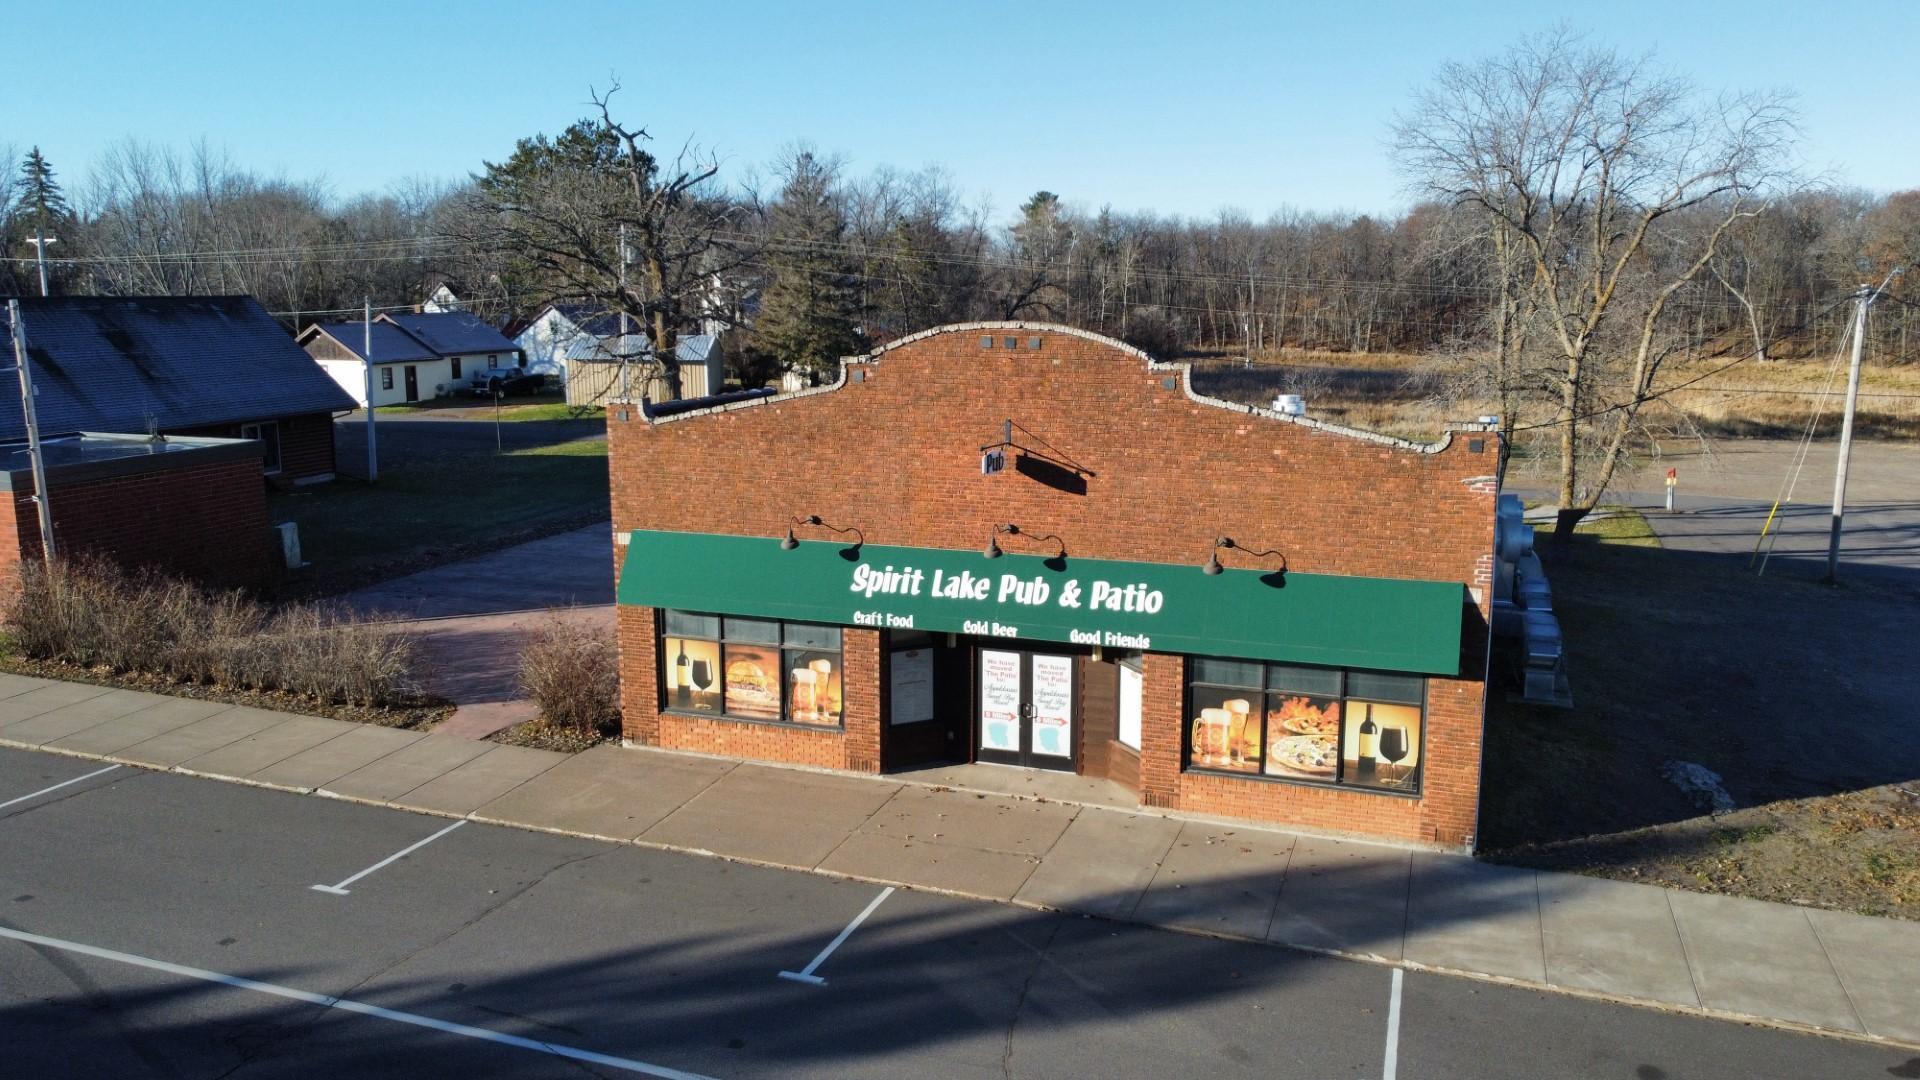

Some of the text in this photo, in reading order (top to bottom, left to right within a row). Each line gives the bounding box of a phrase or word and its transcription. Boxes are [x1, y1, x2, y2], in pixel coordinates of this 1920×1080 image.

[986, 451, 1004, 474] Pub
[850, 563, 1163, 614] Spirit Lake Pub & Patio
[853, 611, 914, 629] Craft Food
[963, 620, 1018, 638] Cold Beer
[1070, 629, 1150, 649] Good Friends
